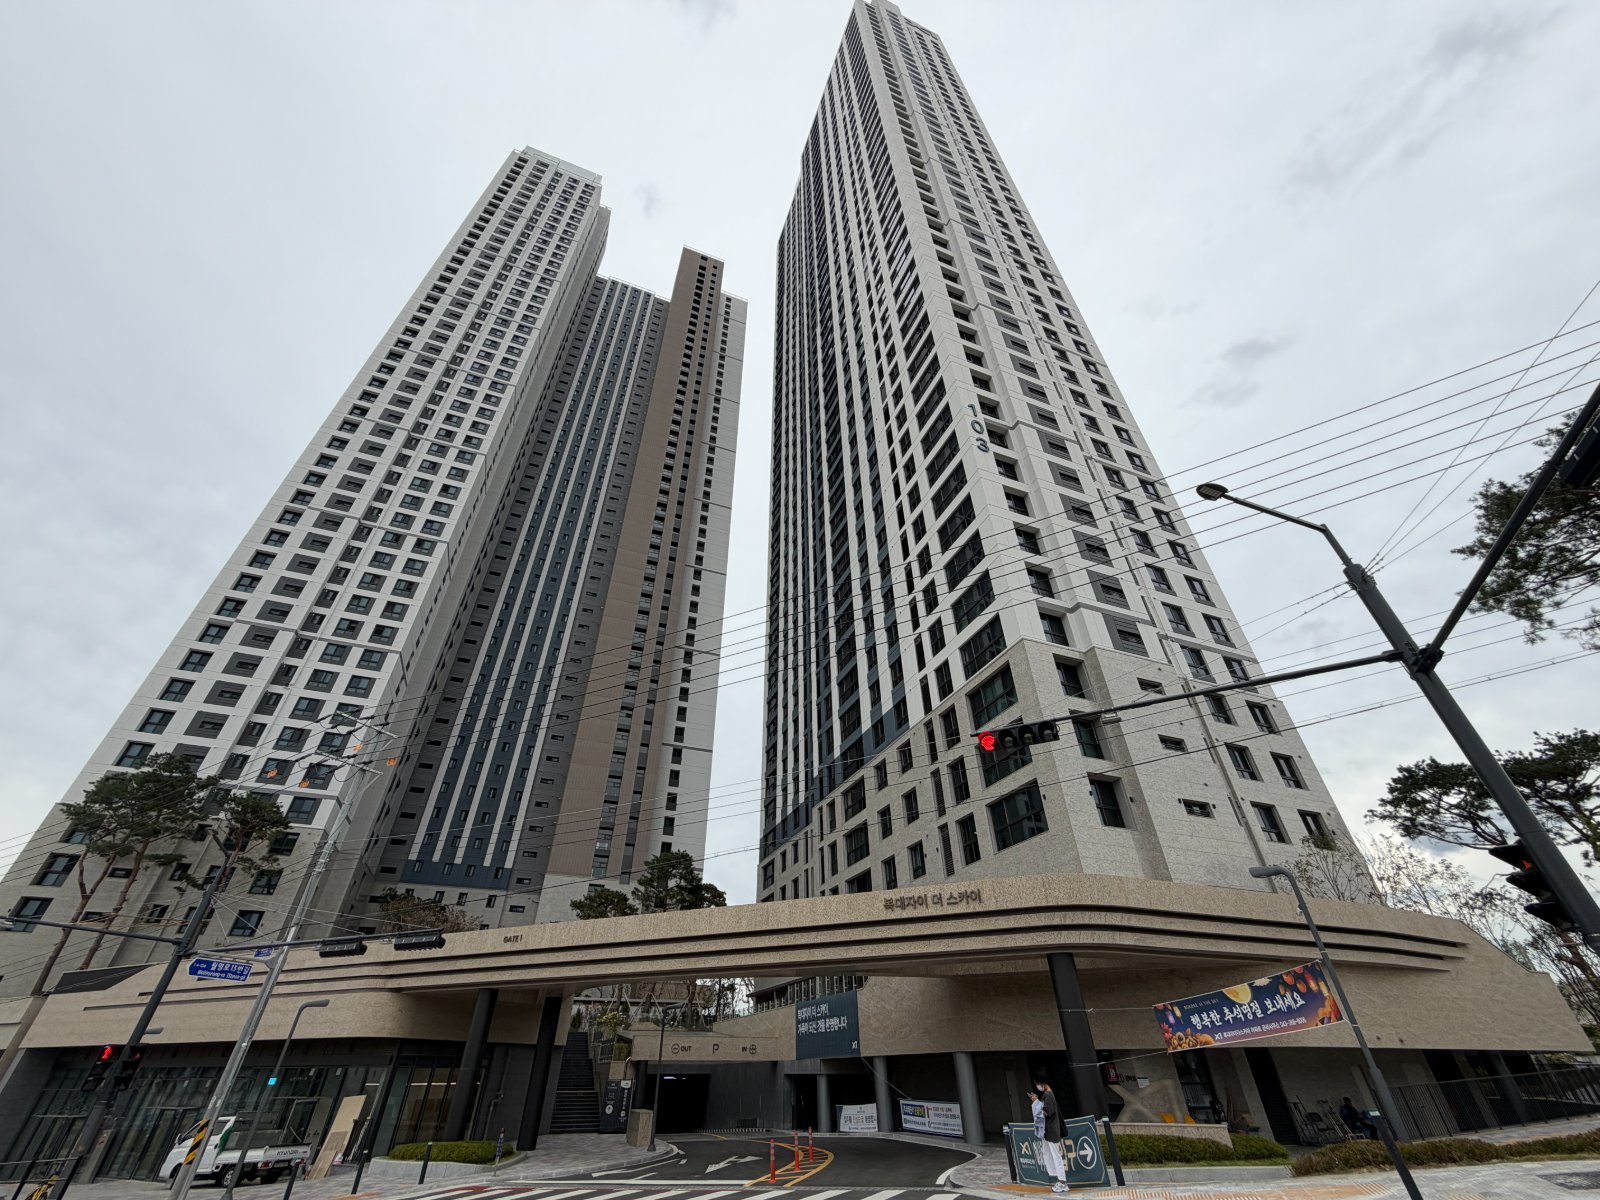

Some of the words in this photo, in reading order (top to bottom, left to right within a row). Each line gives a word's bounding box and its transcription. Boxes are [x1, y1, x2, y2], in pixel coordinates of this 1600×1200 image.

[967, 403, 990, 453] 103
[883, 894, 929, 911] 복대자이
[931, 892, 943, 907] 더
[946, 888, 982, 905] 스카이
[503, 935, 520, 943] GATE
[210, 962, 250, 975] 월명로13번길
[812, 1005, 816, 1018] 더
[817, 1003, 829, 1016] 스카이
[1189, 1010, 1222, 1030] 행복한
[1224, 1000, 1264, 1024] 추석명절
[1264, 991, 1305, 1014] 보내세요
[826, 1015, 847, 1032] 환영합니다
[712, 1043, 719, 1054] P
